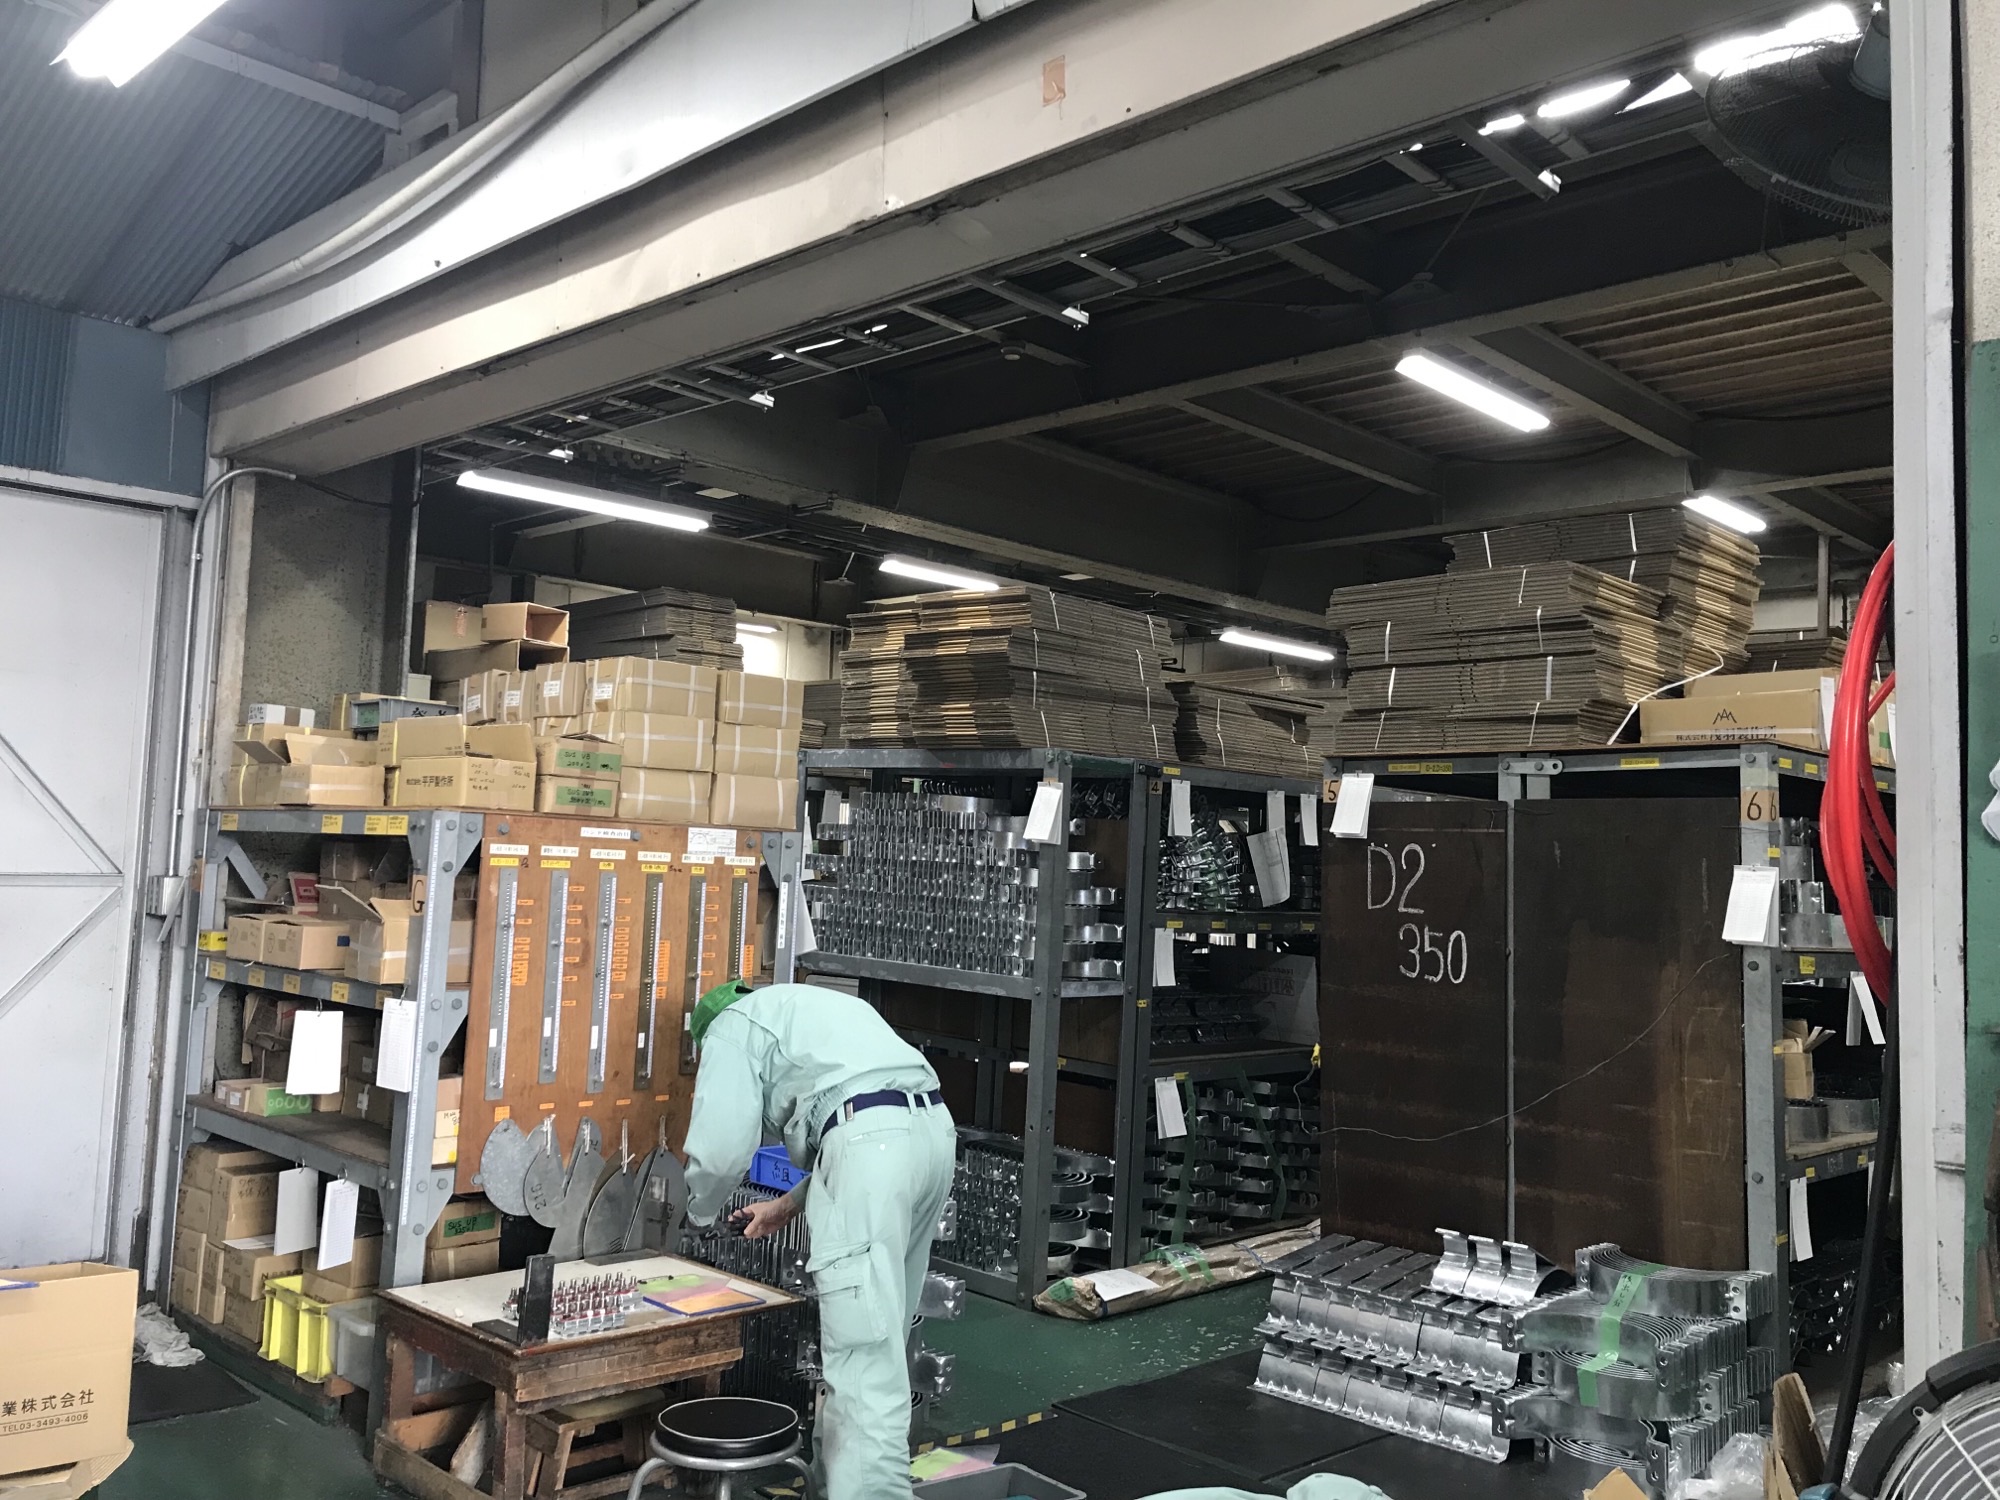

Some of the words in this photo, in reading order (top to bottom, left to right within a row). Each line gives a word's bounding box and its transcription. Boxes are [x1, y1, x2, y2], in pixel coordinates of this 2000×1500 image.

[1151, 782, 1159, 792] 4
[1327, 779, 1340, 802] 5
[1746, 791, 1762, 821] 6
[1768, 792, 1778, 822] 6
[1363, 843, 1425, 915] D2
[413, 880, 425, 913] G
[1399, 922, 1468, 985] 350
[1, 1389, 94, 1417] 業株式会社
[2, 1413, 88, 1433] TEL03-3493-4006
